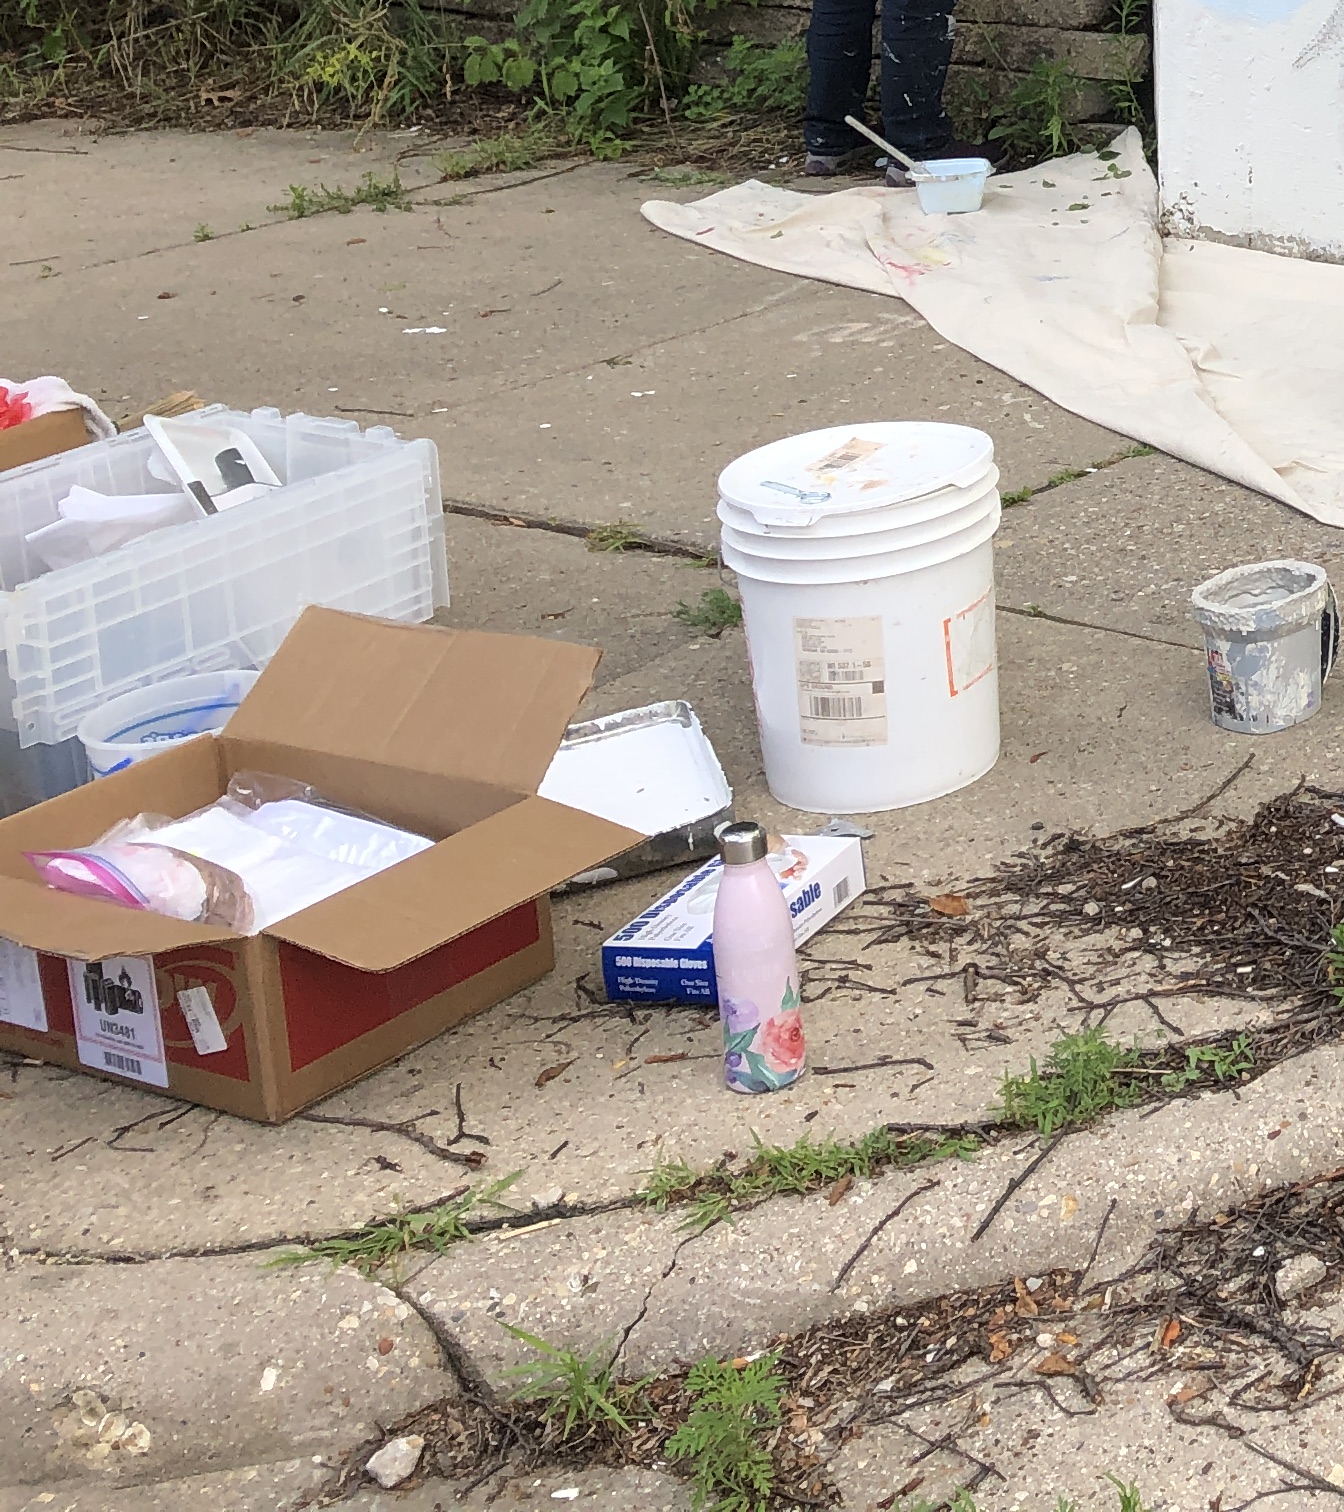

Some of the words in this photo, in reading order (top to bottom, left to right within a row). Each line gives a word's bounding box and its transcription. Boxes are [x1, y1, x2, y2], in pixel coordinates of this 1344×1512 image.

[612, 920, 650, 942] 500
[615, 955, 633, 967] 500
[633, 956, 679, 969] Disposable
[680, 957, 708, 970] Gloves
